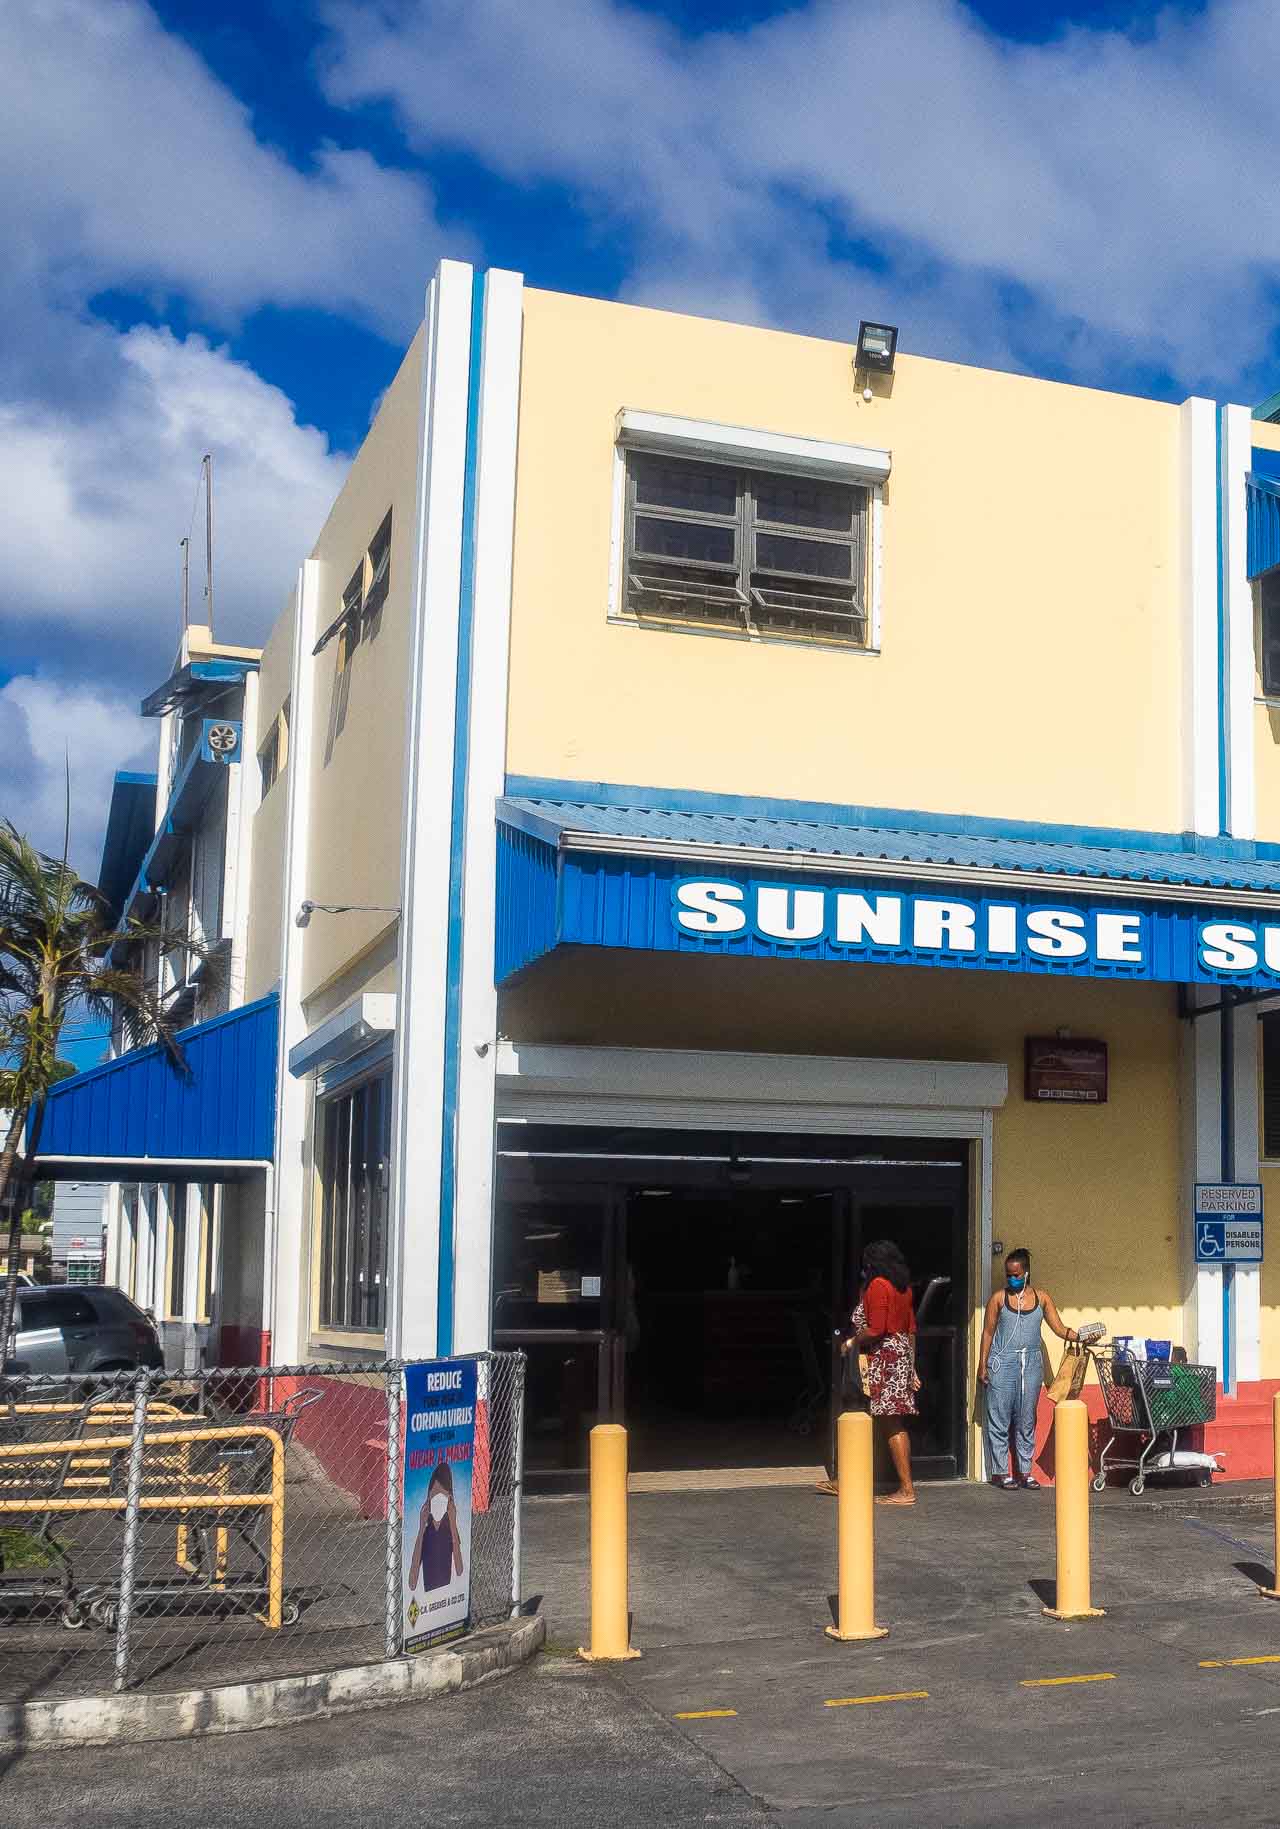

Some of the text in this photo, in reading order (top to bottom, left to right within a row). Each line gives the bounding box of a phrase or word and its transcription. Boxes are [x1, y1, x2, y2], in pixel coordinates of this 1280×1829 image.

[677, 881, 1143, 963] SUNRISE
[1201, 1189, 1255, 1200] RESERVED
[1201, 1201, 1256, 1211] PARKING
[1225, 1231, 1260, 1239] DISABLED
[1225, 1240, 1260, 1248] PERSONS
[427, 1371, 462, 1392] REDUCE
[411, 1406, 474, 1433] CORONAVIRUS
